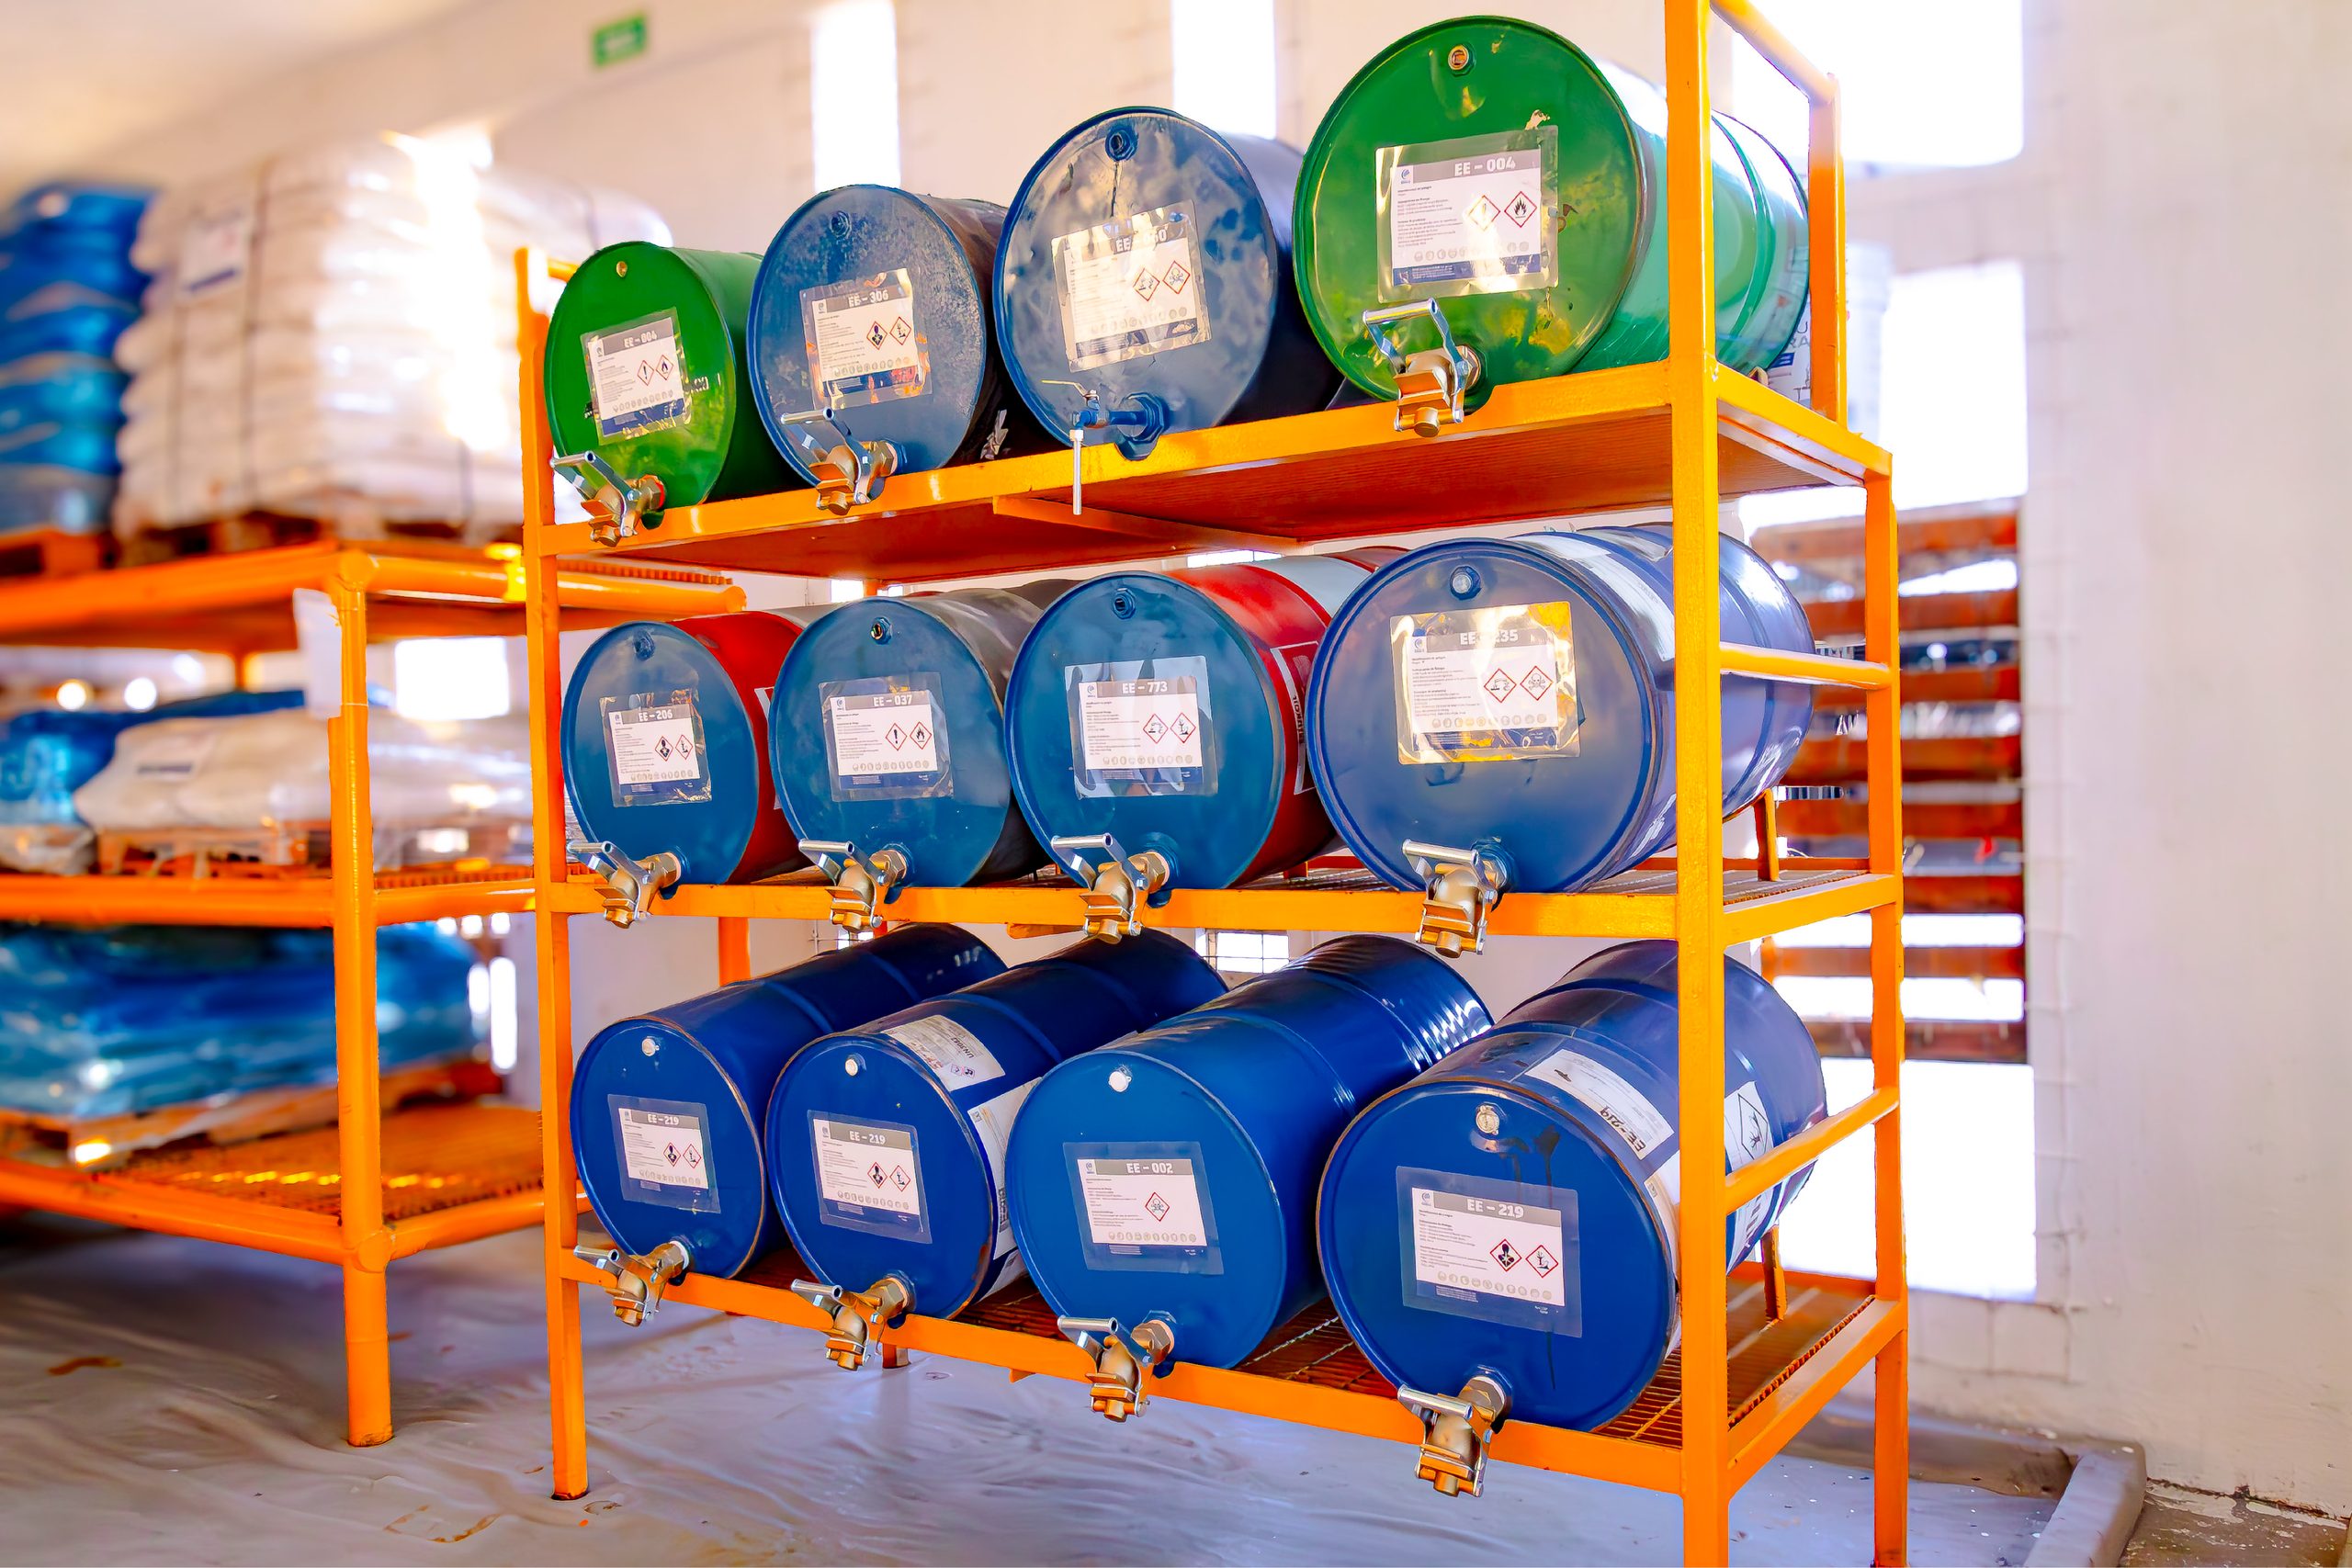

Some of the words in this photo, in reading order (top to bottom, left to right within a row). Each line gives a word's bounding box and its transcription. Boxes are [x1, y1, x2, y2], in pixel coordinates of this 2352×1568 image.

[1454, 163, 1471, 177] EE
[1487, 156, 1516, 173] 004
[848, 292, 861, 308] EE
[869, 289, 889, 303] 306
[1460, 631, 1476, 645] EE
[1496, 628, 1519, 644] 35
[1122, 682, 1136, 694] EE
[1147, 681, 1168, 693] 773
[873, 696, 885, 707] EE
[894, 694, 912, 705] 037
[638, 712, 649, 722] EE
[655, 708, 673, 720] 206
[647, 1113, 658, 1123] EE
[664, 1115, 680, 1125] 219
[849, 1130, 861, 1142] EE
[868, 1133, 886, 1145] 219
[1126, 1162, 1141, 1174] EE
[1151, 1162, 1174, 1174] 002
[1466, 1198, 1484, 1213] EE
[1498, 1203, 1524, 1219] 219
